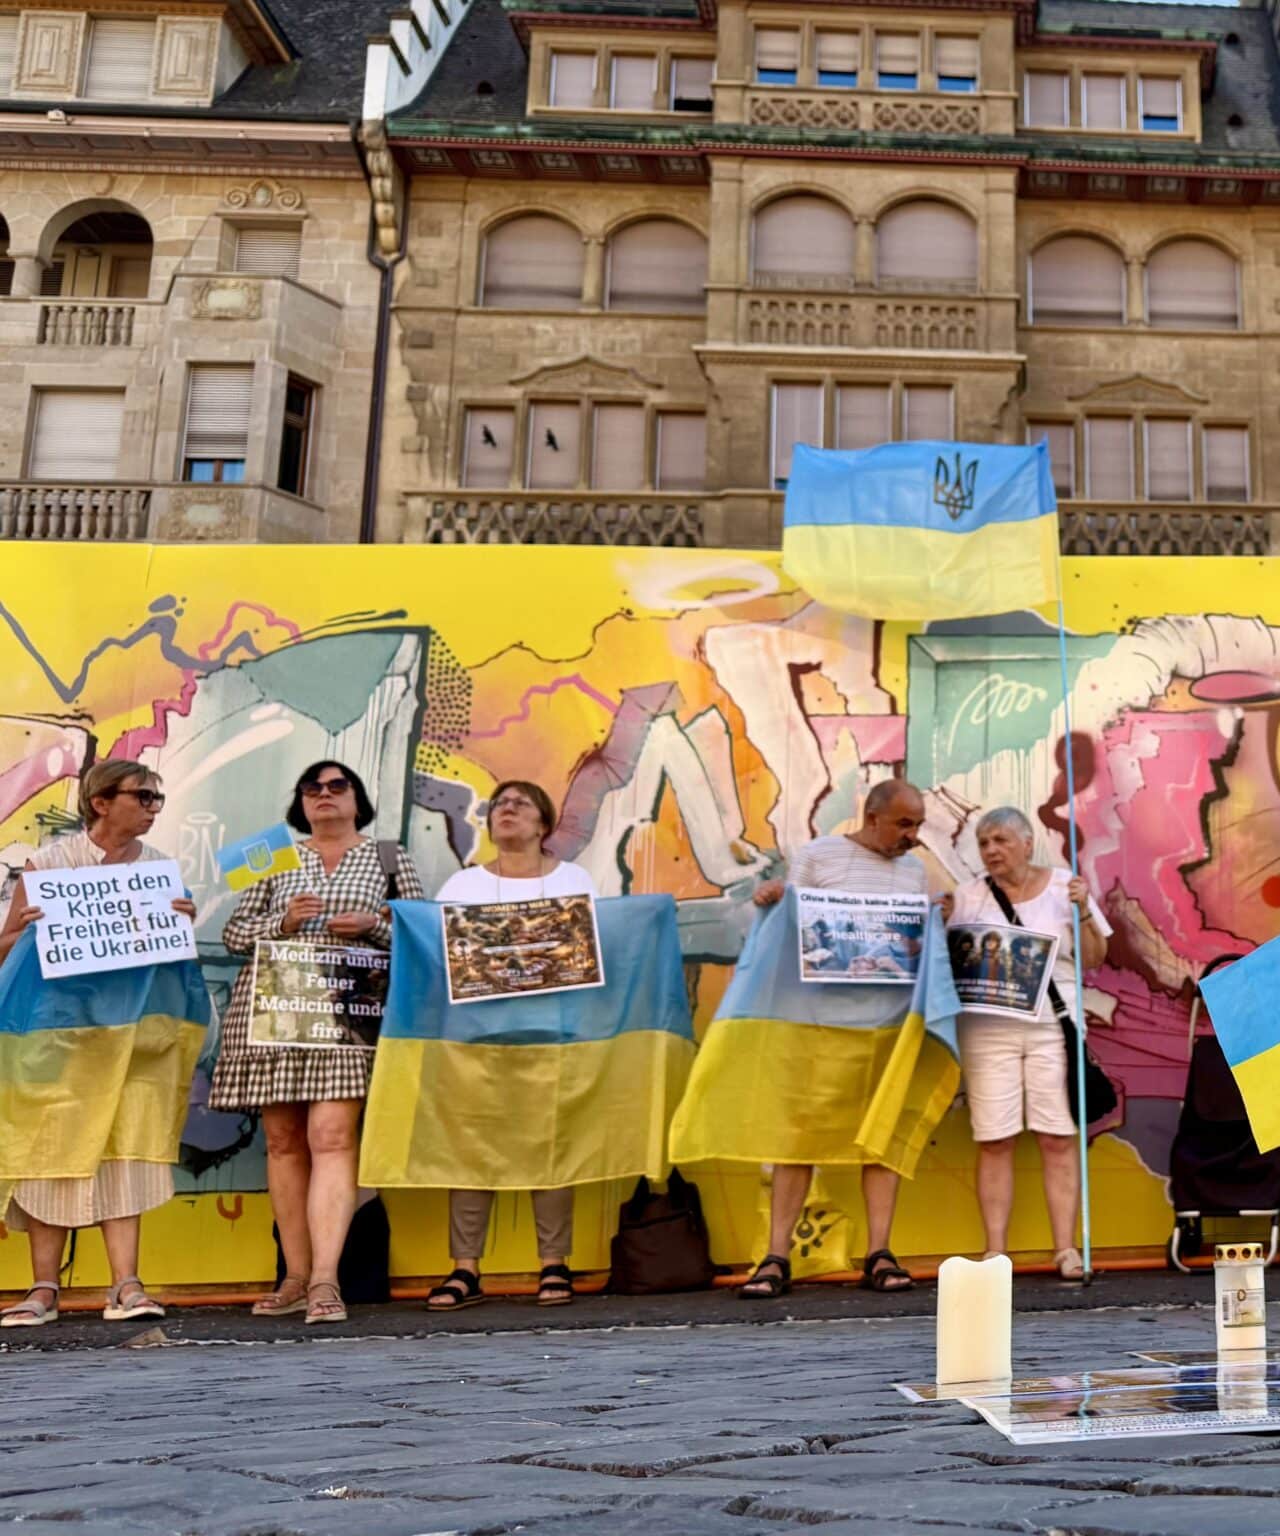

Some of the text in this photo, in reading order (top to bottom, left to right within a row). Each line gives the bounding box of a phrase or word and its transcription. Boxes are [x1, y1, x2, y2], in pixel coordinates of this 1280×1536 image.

[39, 872, 171, 900] Stoppt den
[67, 898, 133, 918] Krieg
[800, 893, 825, 902] Ohne
[828, 896, 862, 905] Medizin
[48, 911, 179, 942] Freiheit für
[874, 912, 921, 924] without
[831, 930, 901, 941] healthcare
[46, 930, 190, 964] die Ukraine!
[270, 943, 390, 970] Medizin unter
[305, 973, 357, 991] Feuer
[259, 995, 345, 1015] Medicine
[311, 1021, 343, 1039] fire
